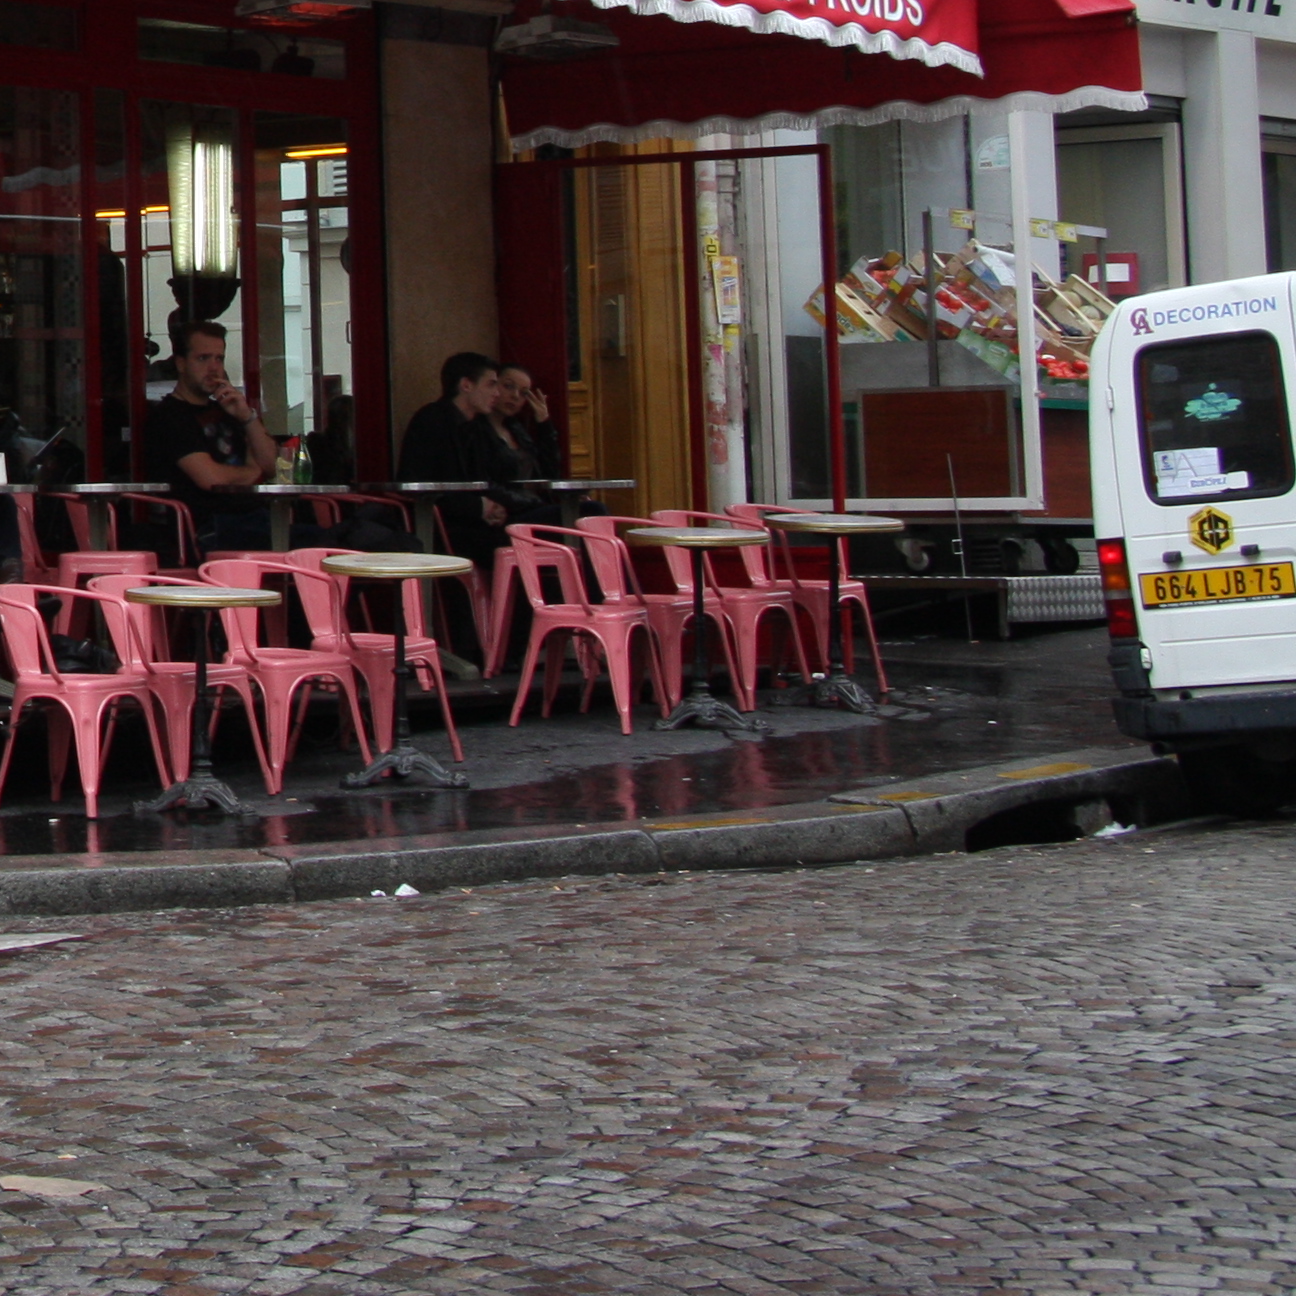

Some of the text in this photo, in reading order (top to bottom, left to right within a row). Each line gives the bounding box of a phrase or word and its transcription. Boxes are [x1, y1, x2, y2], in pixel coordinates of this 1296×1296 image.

[1153, 297, 1277, 326] DECORATION
[1154, 574, 1197, 601] 664
[1203, 570, 1246, 597] LJB
[1254, 567, 1282, 592] 75
